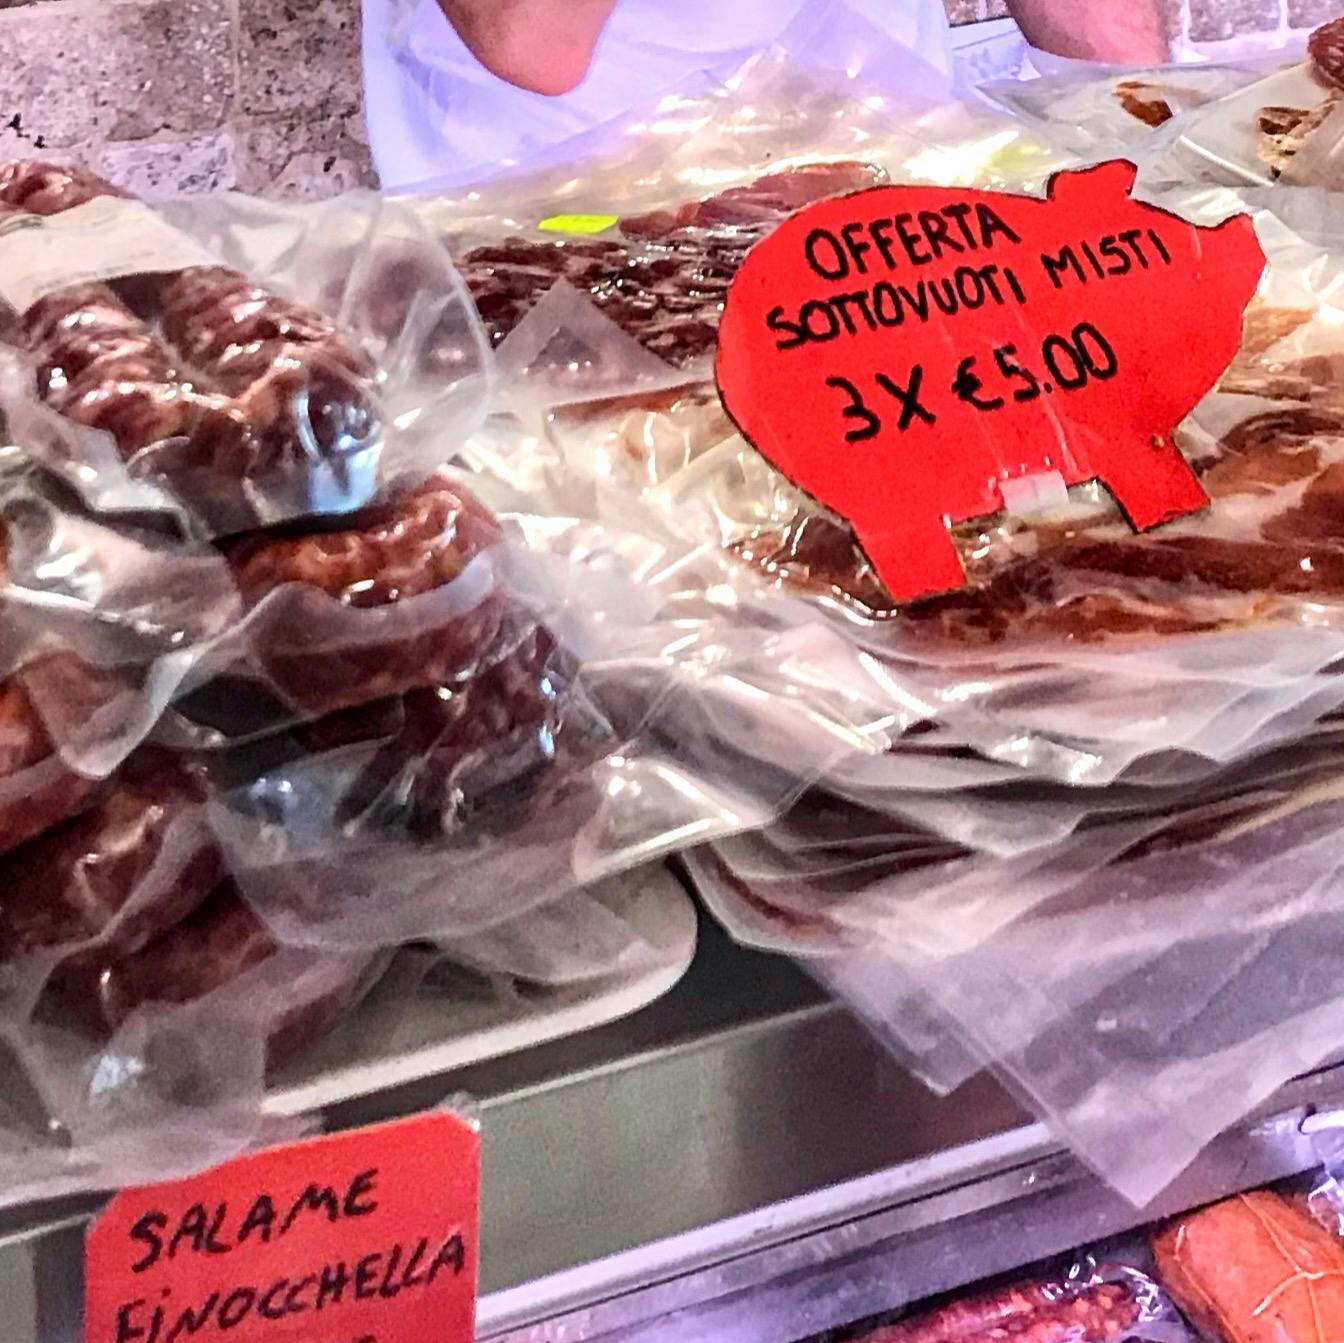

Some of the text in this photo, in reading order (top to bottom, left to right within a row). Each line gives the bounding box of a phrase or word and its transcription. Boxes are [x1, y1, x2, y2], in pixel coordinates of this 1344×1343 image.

[766, 228, 1172, 351] SOTTOVUOTI MISTI
[805, 202, 1021, 281] OFFERTA
[826, 376, 881, 443] 3
[951, 322, 1119, 412] €5.00
[128, 1167, 380, 1274] SALAME
